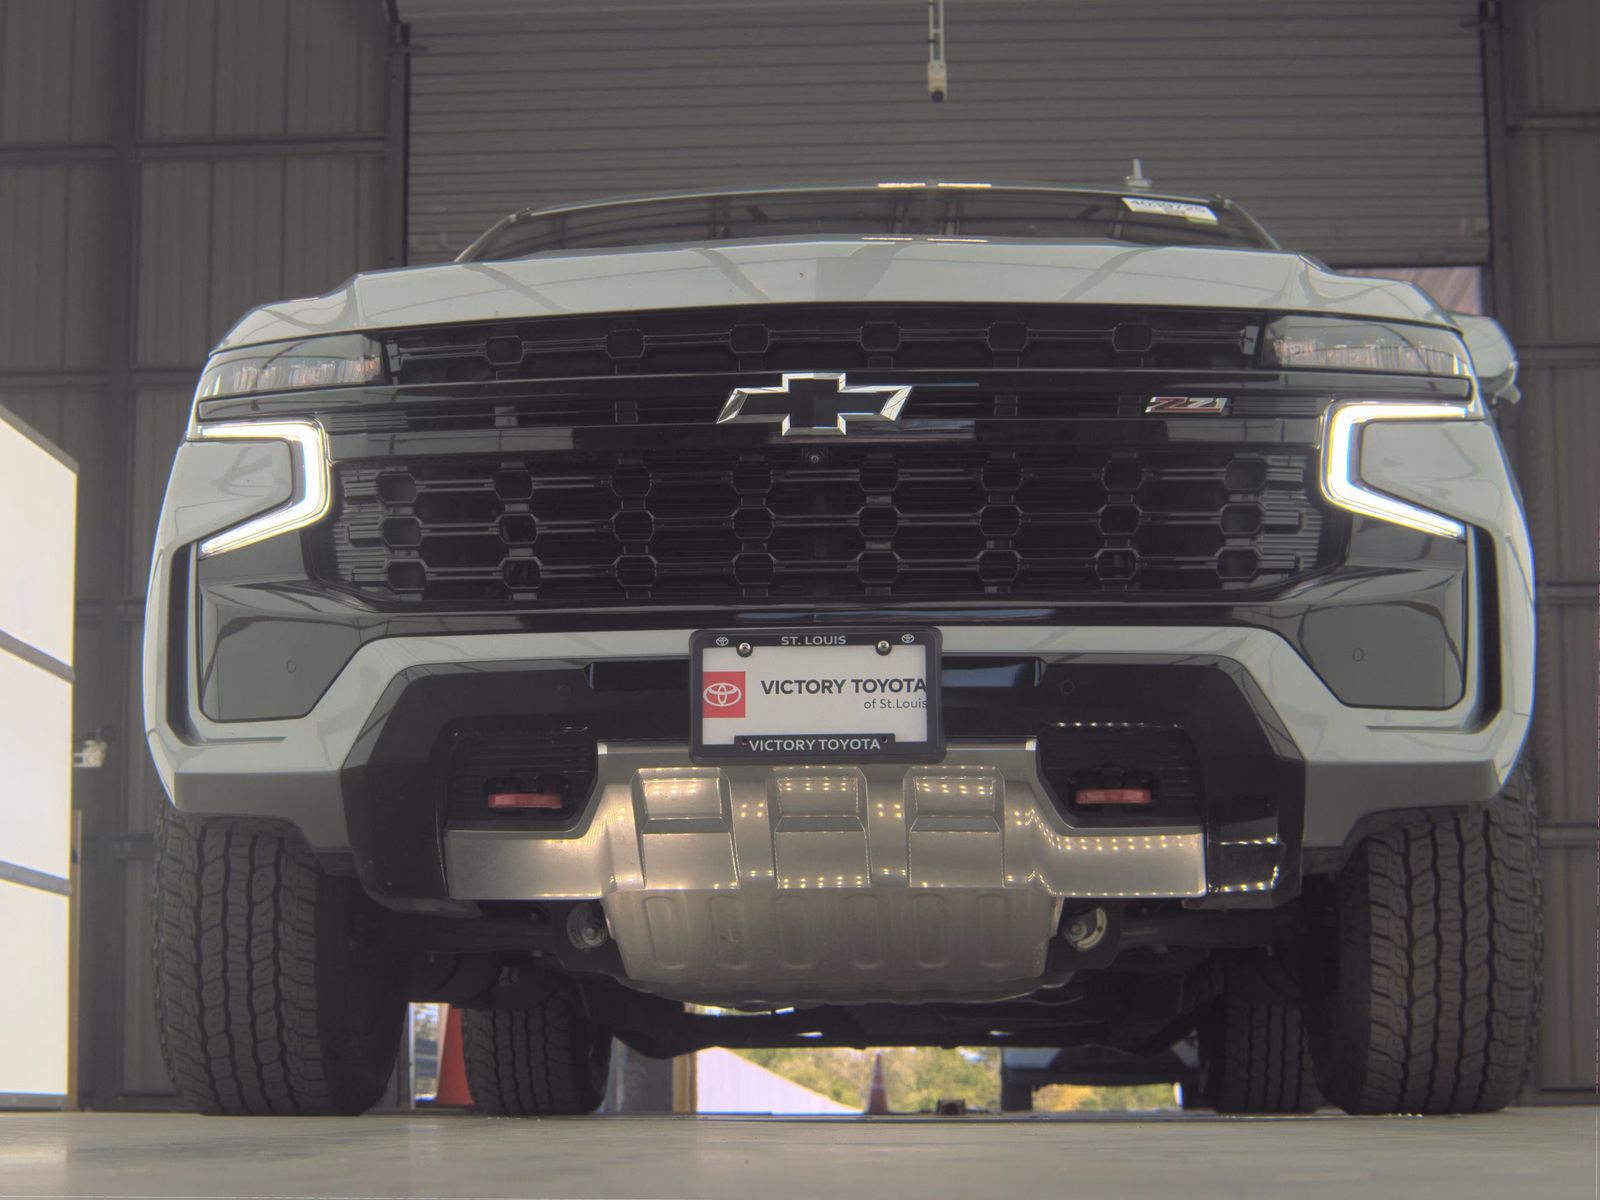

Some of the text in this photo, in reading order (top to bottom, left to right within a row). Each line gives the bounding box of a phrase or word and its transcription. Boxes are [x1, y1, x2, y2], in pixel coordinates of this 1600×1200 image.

[1145, 396, 1228, 413] Z71
[781, 635, 847, 645] ST. LOUIS
[761, 678, 927, 694] VICTORY TOYOTA
[864, 699, 877, 709] of
[749, 738, 881, 750] VICTORY TOYOTA
